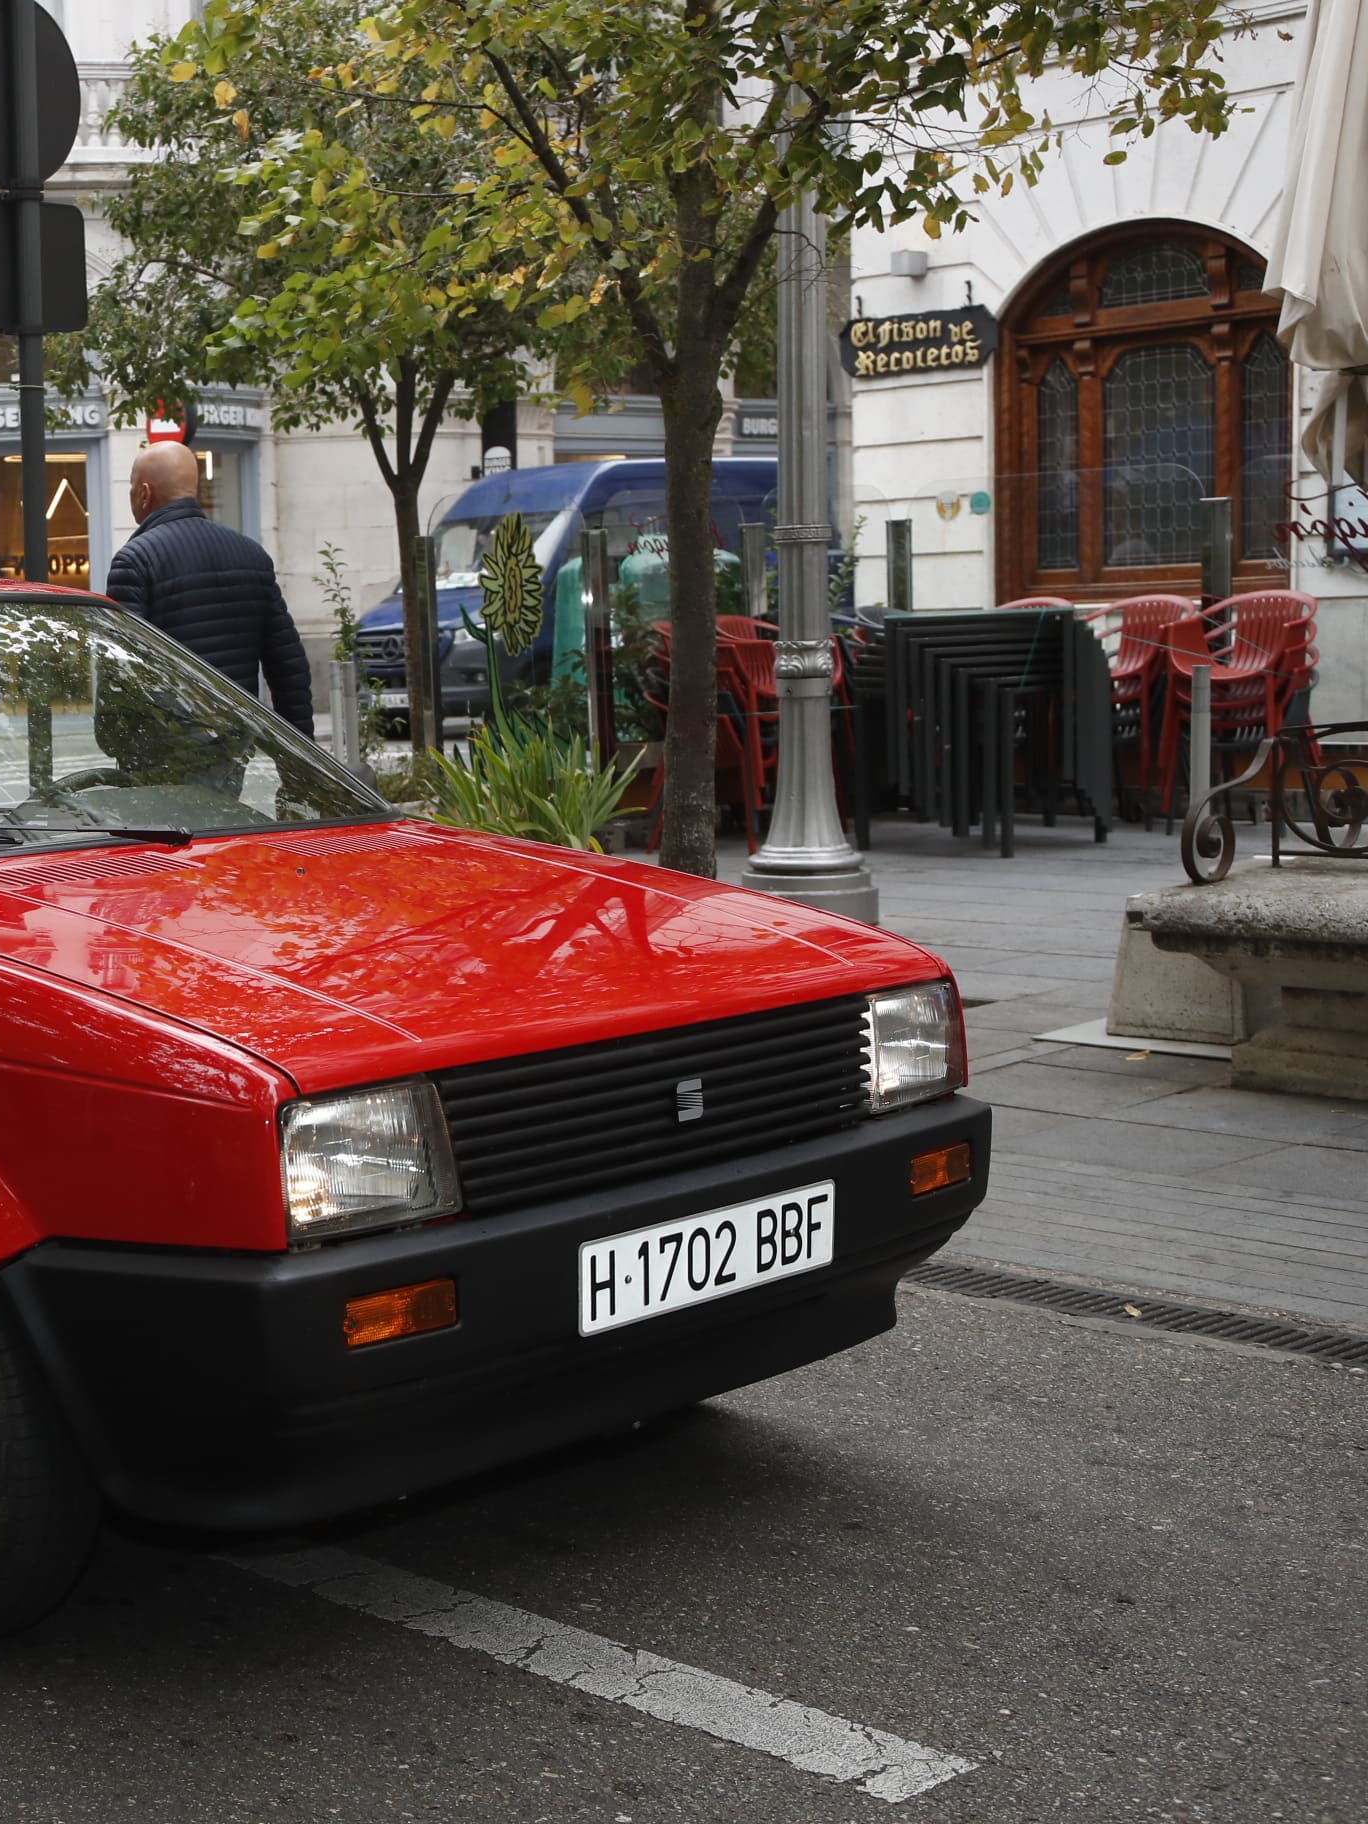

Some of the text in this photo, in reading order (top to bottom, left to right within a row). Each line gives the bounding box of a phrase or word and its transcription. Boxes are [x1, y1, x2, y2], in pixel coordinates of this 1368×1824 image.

[855, 339, 982, 376] Recoletos
[742, 417, 778, 435] BURG
[756, 1193, 829, 1274] BBF
